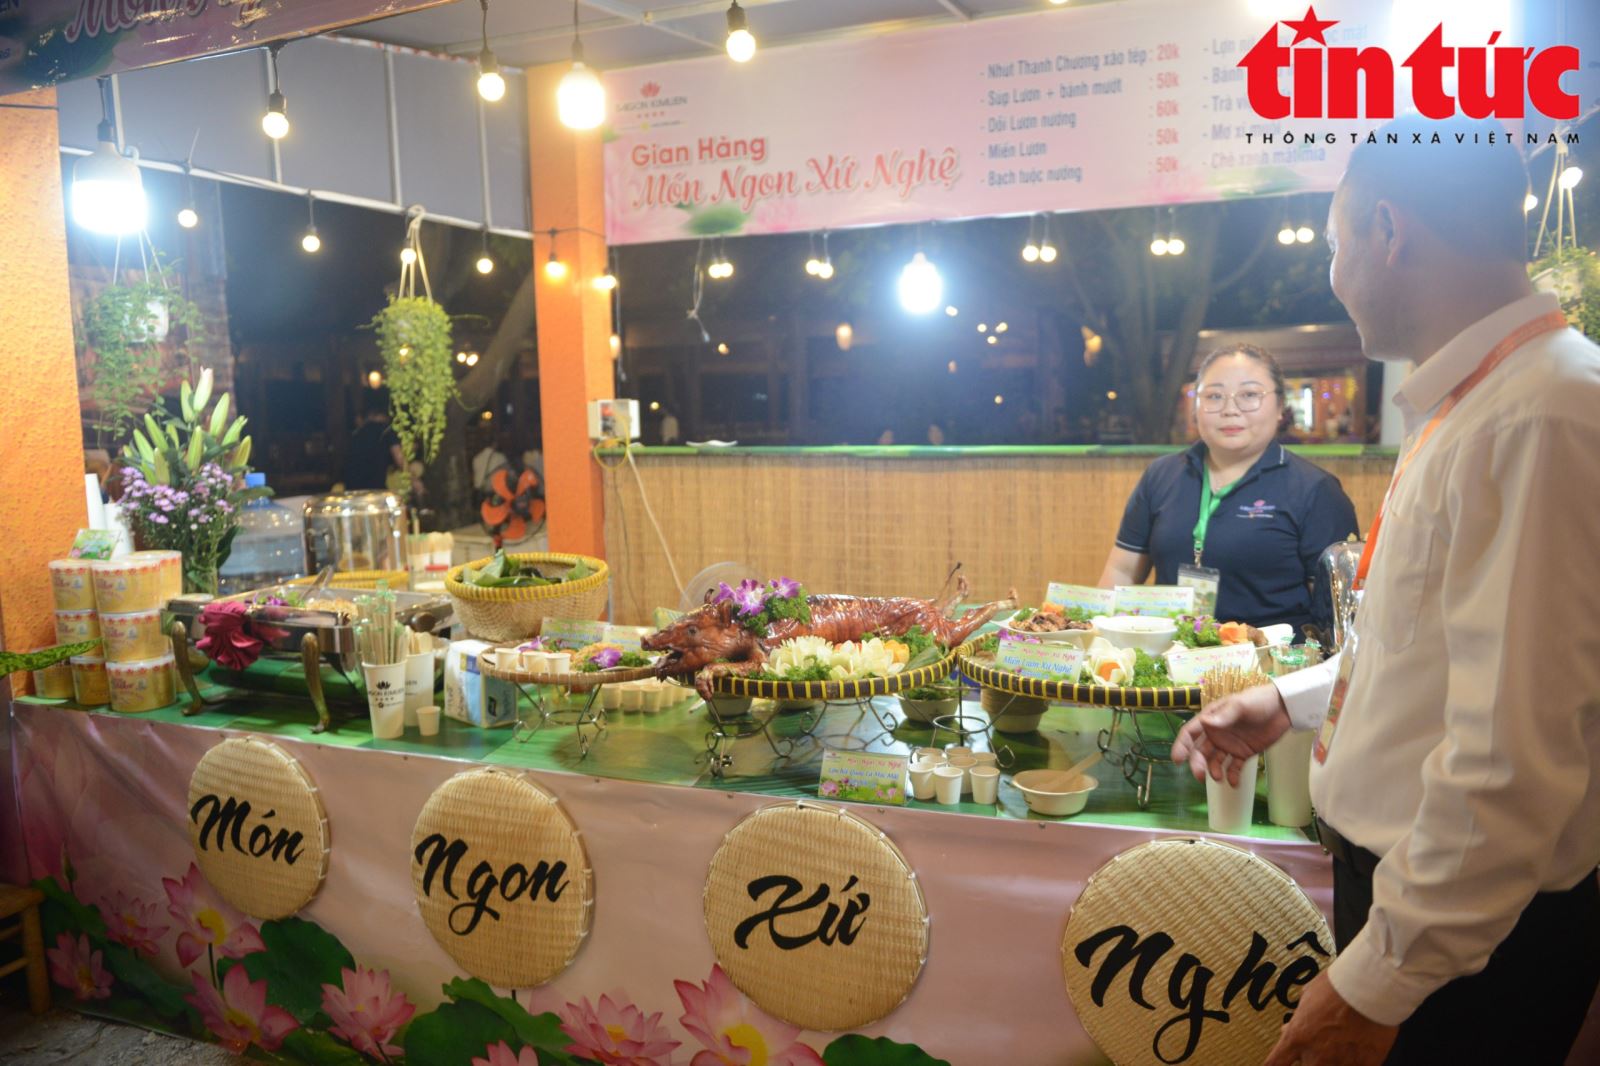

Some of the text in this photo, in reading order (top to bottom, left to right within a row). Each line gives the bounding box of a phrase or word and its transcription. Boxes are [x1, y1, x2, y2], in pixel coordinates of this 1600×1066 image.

[1157, 43, 1179, 61] 20k
[1157, 72, 1179, 88] 50k
[632, 136, 766, 166] Gian Hàng
[1156, 128, 1179, 145] 50k
[711, 165, 796, 212] Ngon
[806, 154, 857, 191] Xứ
[864, 147, 957, 198] Nghệ
[1156, 156, 1179, 173] 50k
[190, 794, 304, 866] Món
[414, 833, 570, 936] Ngon
[733, 875, 871, 950] Xứ
[1074, 925, 1331, 1064] Nghệ
